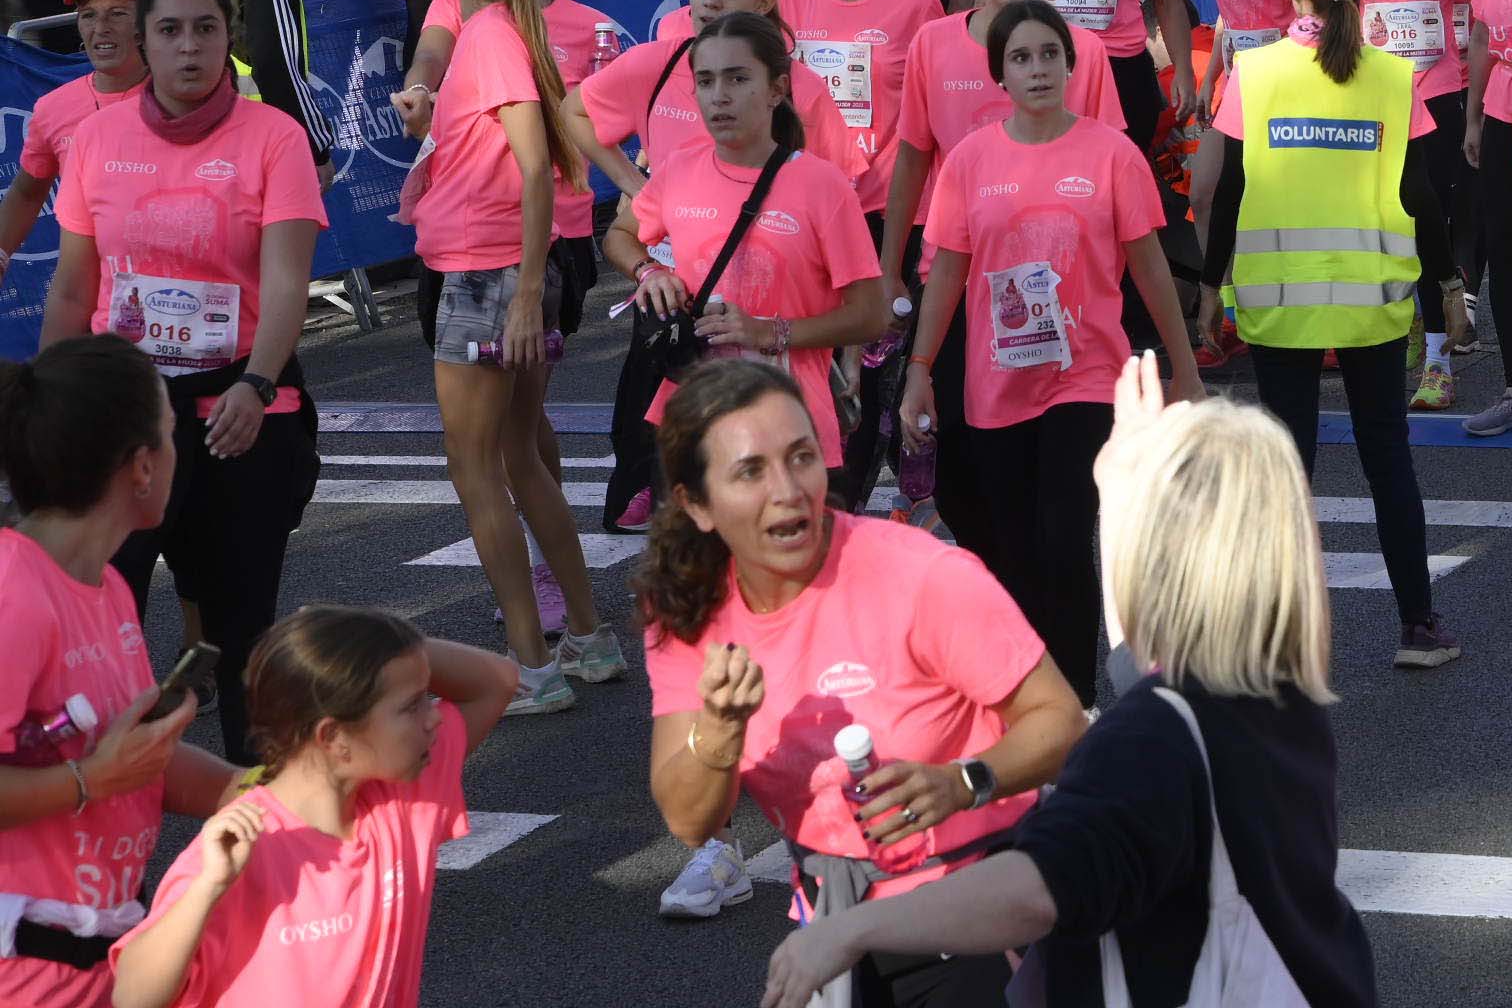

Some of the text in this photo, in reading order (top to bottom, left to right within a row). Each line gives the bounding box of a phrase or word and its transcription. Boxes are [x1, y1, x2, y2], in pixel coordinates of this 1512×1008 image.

[1390, 29, 1417, 40] 016
[654, 104, 698, 123] OYSHO
[1270, 125, 1376, 143] VOLUNTARIS
[104, 160, 157, 175] OYSHO
[979, 182, 1019, 198] OYSHO
[674, 206, 718, 219] OYSHO
[759, 215, 797, 233] ASTURIANA
[149, 296, 196, 311] ASTURIANA
[149, 322, 191, 342] 016
[1009, 335, 1040, 345] CARRERA
[155, 343, 182, 356] 3038
[1008, 348, 1043, 362] OYSHO
[280, 912, 354, 945] OYSHO
